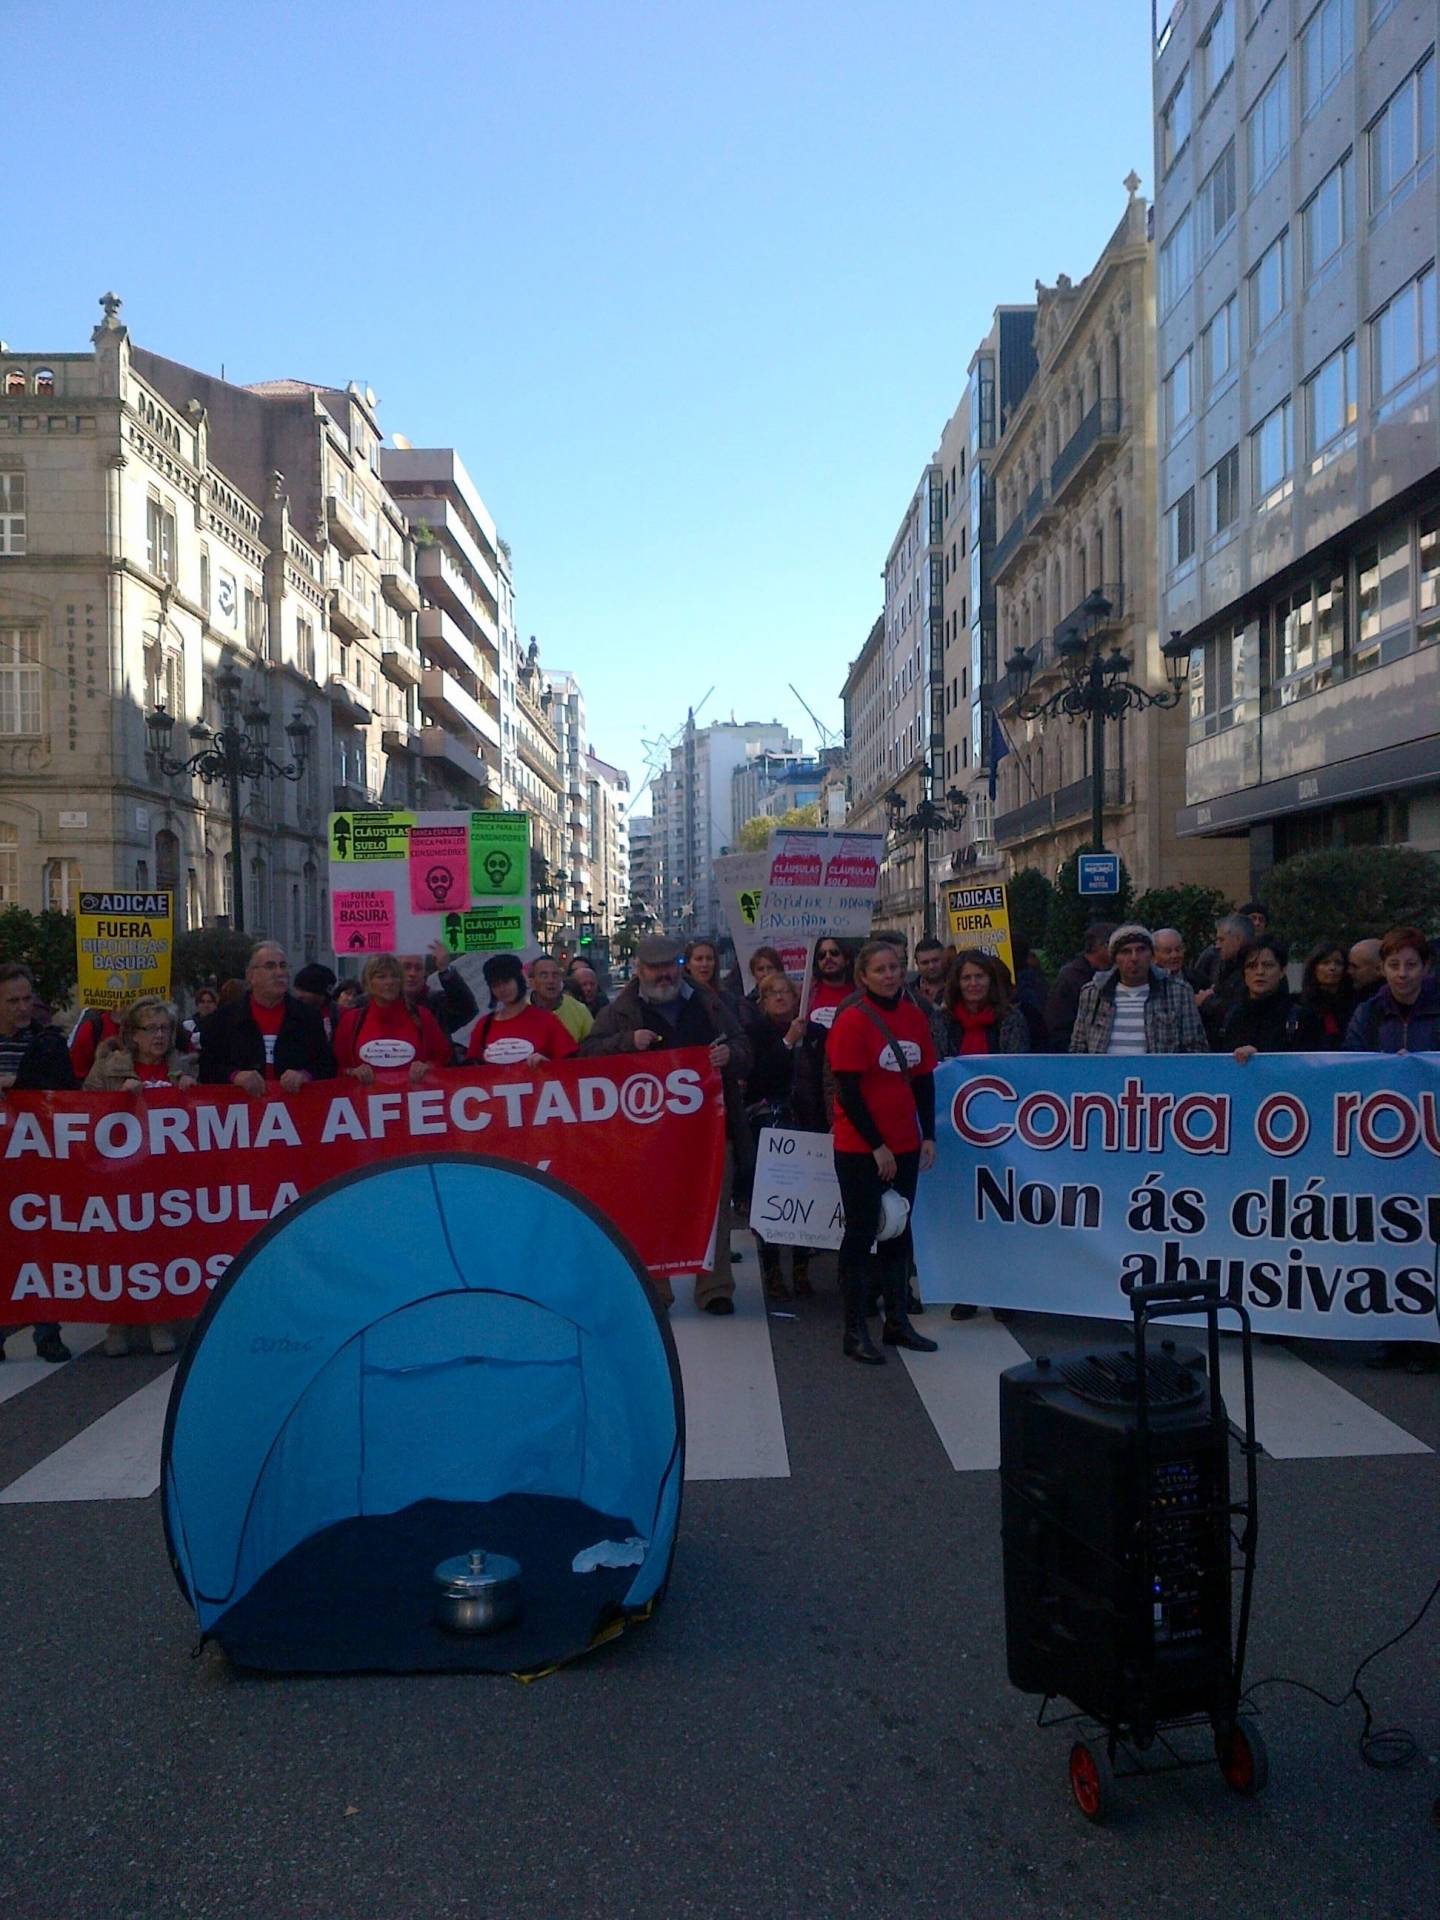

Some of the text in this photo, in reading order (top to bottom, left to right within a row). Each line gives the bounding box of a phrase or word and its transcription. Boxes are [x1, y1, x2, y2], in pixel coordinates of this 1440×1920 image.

[355, 827, 409, 837] CLÁUSULAS
[355, 841, 386, 850] SUELO
[100, 895, 168, 911] ADICAE
[957, 888, 1002, 908] ADICAE
[340, 911, 388, 922] BASURA
[465, 919, 519, 929] CLÁUSULAS
[956, 914, 992, 931] FUERA
[97, 921, 152, 938] FUERA
[466, 933, 495, 942] SUELO
[81, 938, 168, 954] HIPOTECAS
[93, 955, 158, 970] BASURA
[320, 1069, 704, 1143] AFECTAD@S
[952, 1075, 1230, 1154] Contra
[1255, 1091, 1309, 1157] o
[0, 1103, 302, 1159] AFORMA
[769, 1136, 795, 1154] NO
[976, 1165, 1102, 1230] Non
[1127, 1171, 1207, 1236] ás
[760, 1195, 815, 1224] SON
[1119, 1241, 1436, 1316] abusivas
